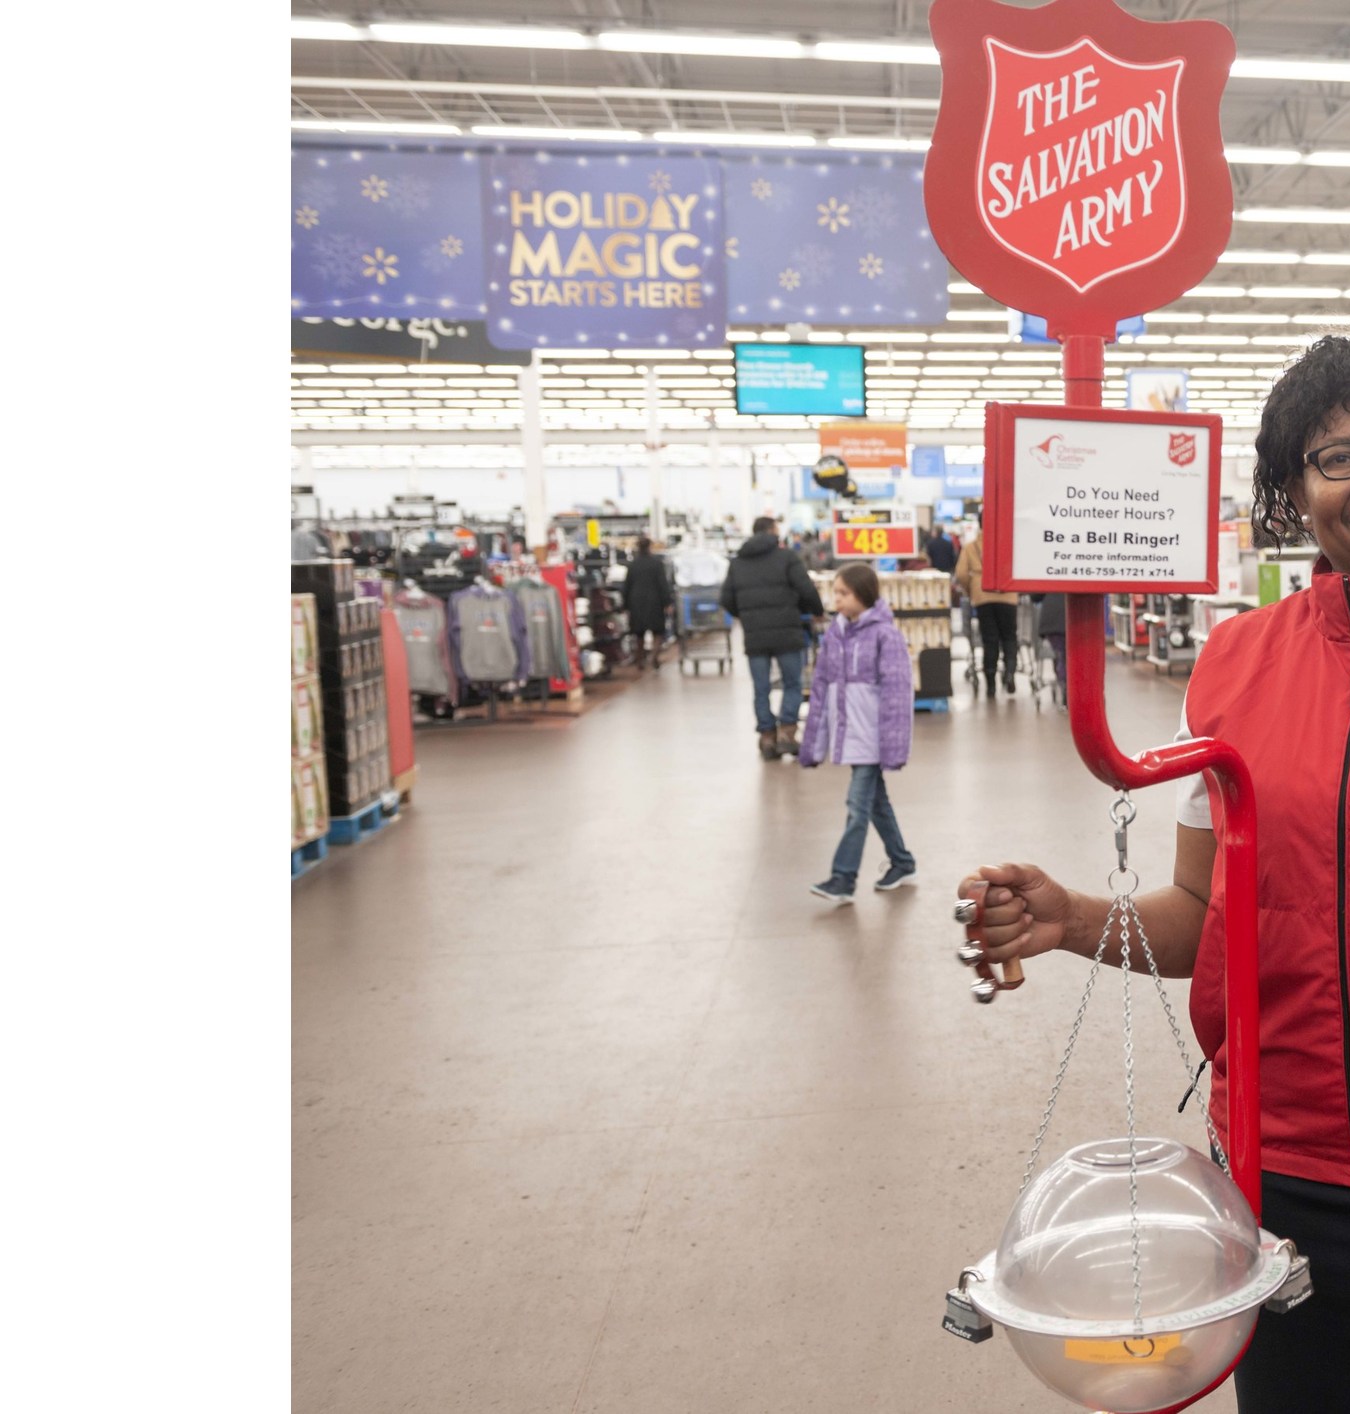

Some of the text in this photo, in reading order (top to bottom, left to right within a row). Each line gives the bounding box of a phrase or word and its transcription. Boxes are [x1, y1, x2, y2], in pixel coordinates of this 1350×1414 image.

[1017, 64, 1100, 137] THE
[987, 89, 1167, 218] SALVATION
[1053, 159, 1164, 260] ARMY
[509, 229, 701, 280] MAGIC
[509, 279, 703, 308] STARTS HERE
[1066, 486, 1160, 502] Do You Need
[1048, 504, 1175, 521] Volunteer Hours?
[845, 528, 889, 555] $48
[1043, 530, 1180, 548] Be a Bell Ringer!
[1053, 551, 1169, 562] For more information
[1046, 566, 1175, 577] Call 416-759-1721 x714
[1287, 1289, 1313, 1309] Master
